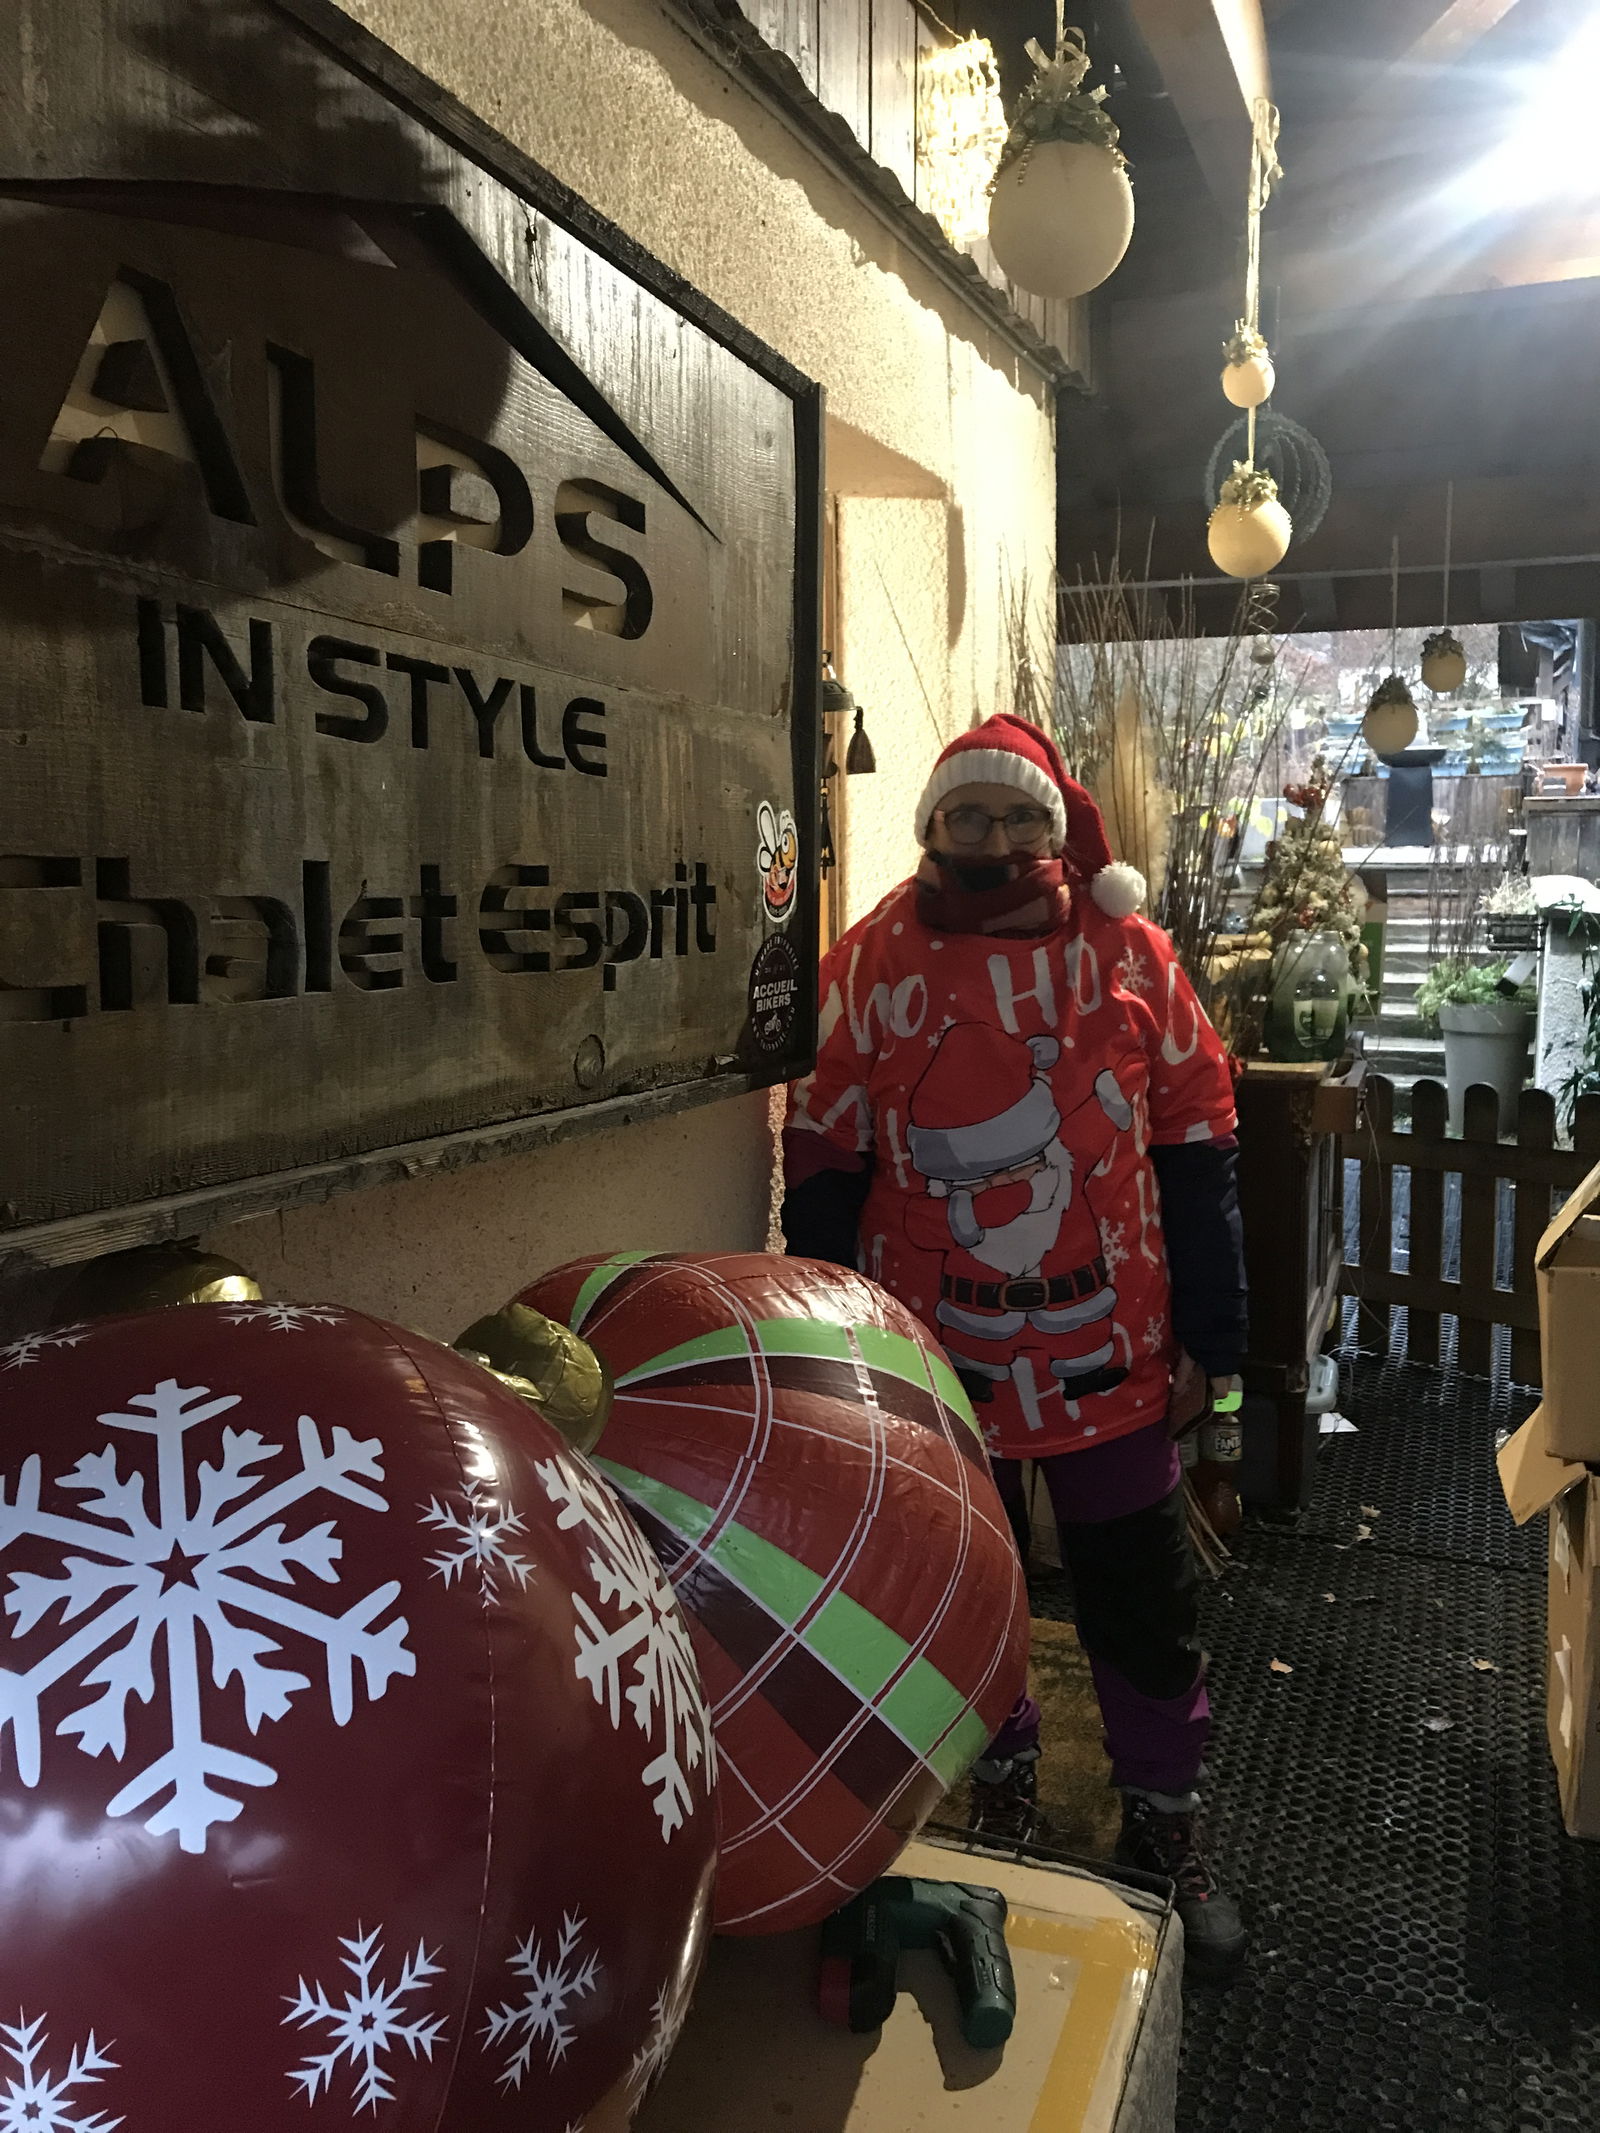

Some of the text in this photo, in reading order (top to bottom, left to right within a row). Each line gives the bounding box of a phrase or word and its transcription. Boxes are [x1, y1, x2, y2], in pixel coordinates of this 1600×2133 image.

[37, 263, 654, 641] ALPS
[138, 600, 609, 778] IN STYLE
[479, 861, 717, 992] Esprit
[753, 978, 798, 1000] ACCUEIL
[756, 992, 792, 1013] BIKERS
[1215, 1435, 1242, 1451] FANT
